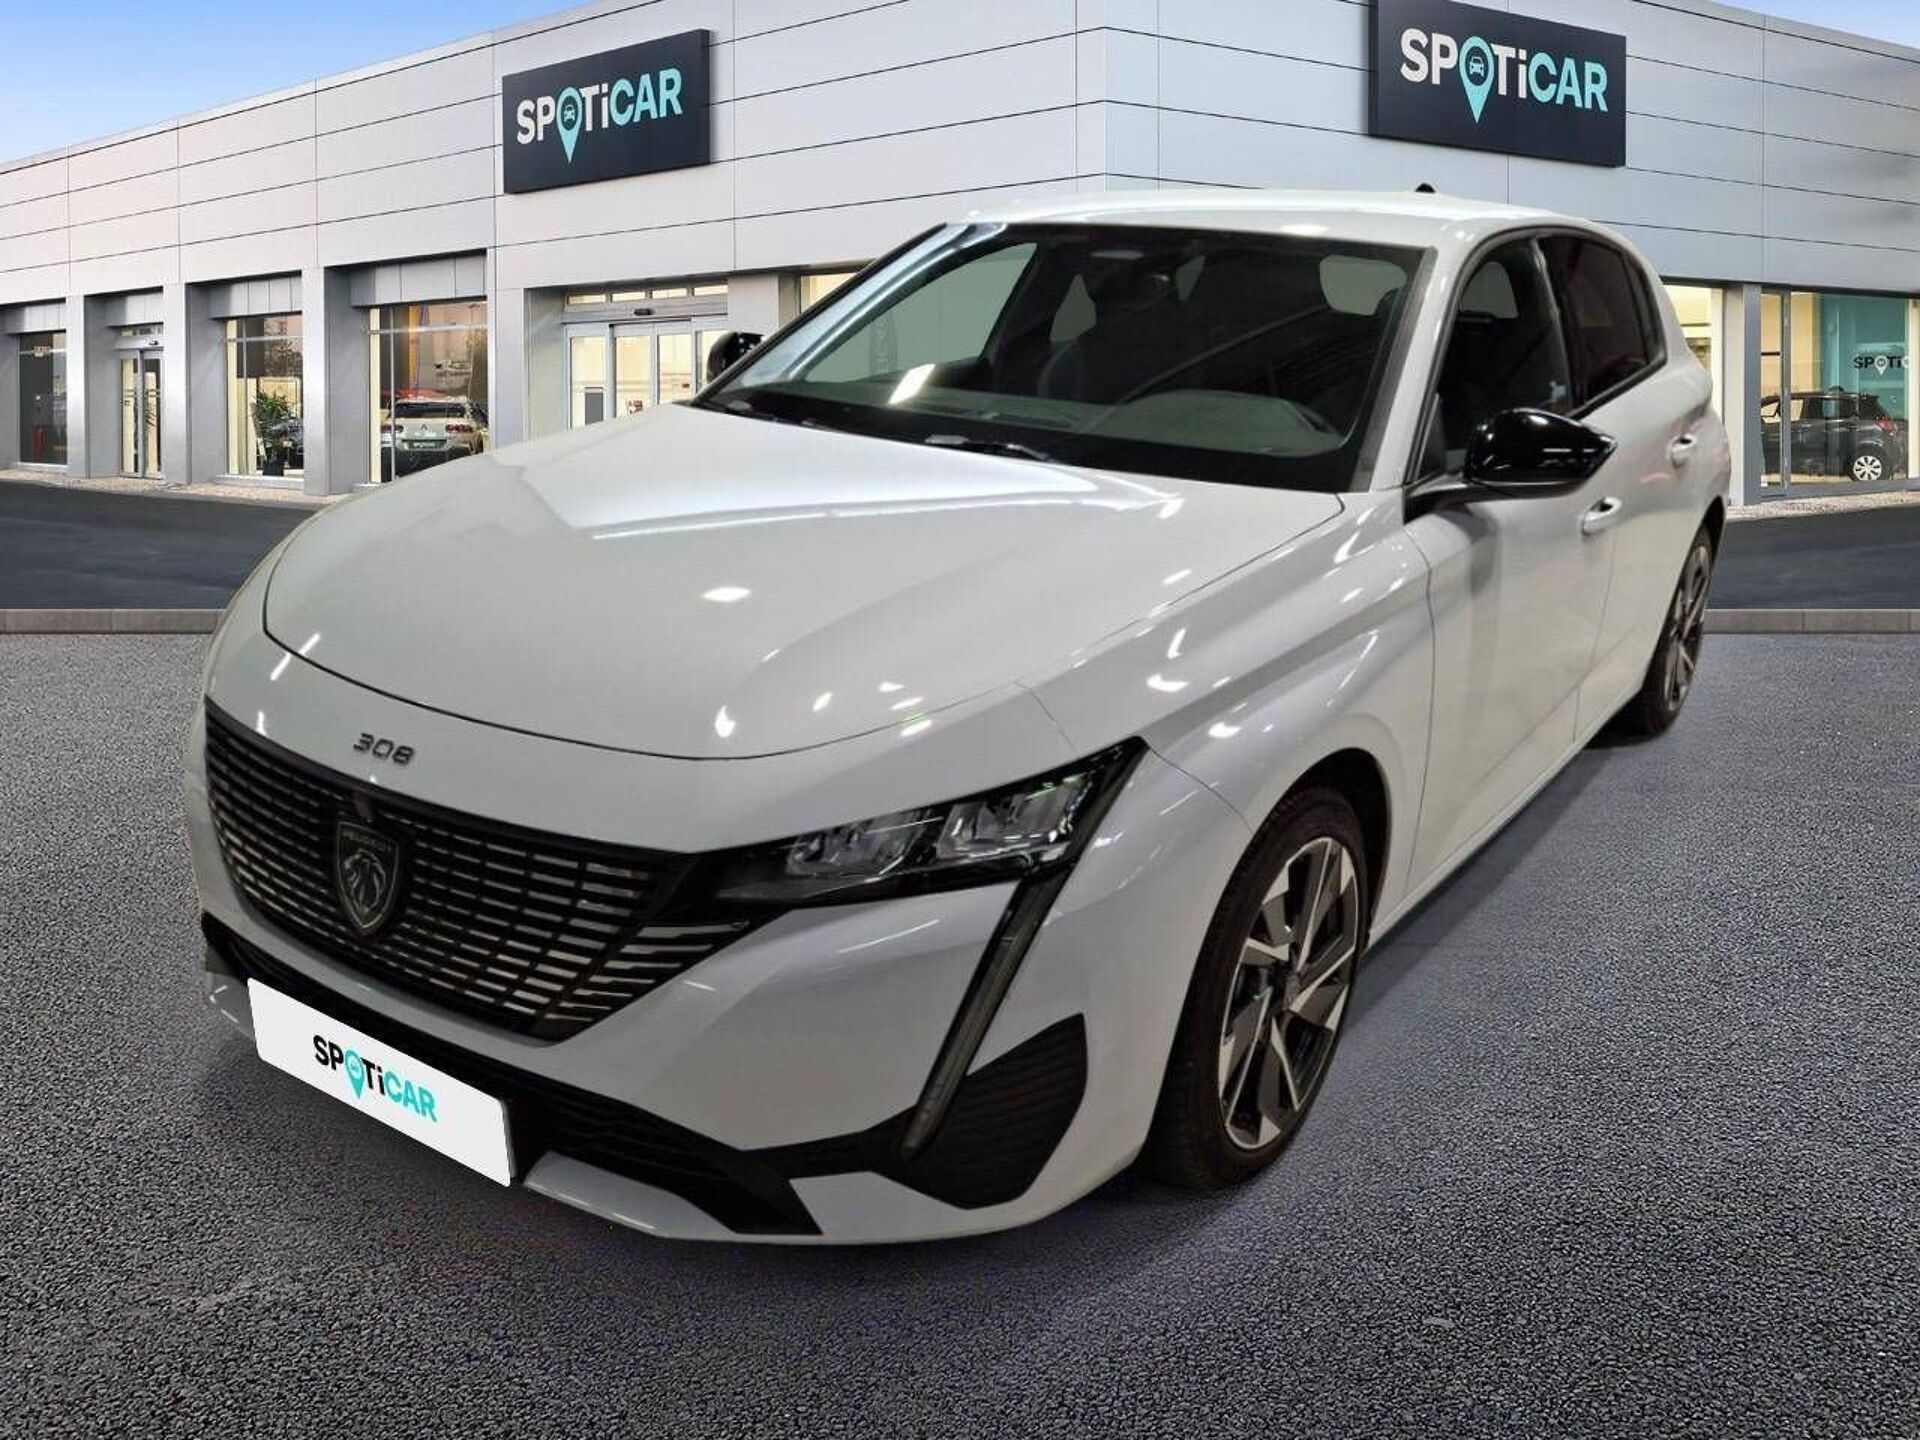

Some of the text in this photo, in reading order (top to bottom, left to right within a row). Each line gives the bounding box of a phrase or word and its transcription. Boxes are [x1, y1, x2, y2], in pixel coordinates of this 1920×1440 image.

[516, 68, 683, 164] SPOTiCAR
[1400, 28, 1608, 123] SPOTiCAR
[353, 732, 414, 765] 308
[313, 1034, 437, 1123] SPOTiCAR
